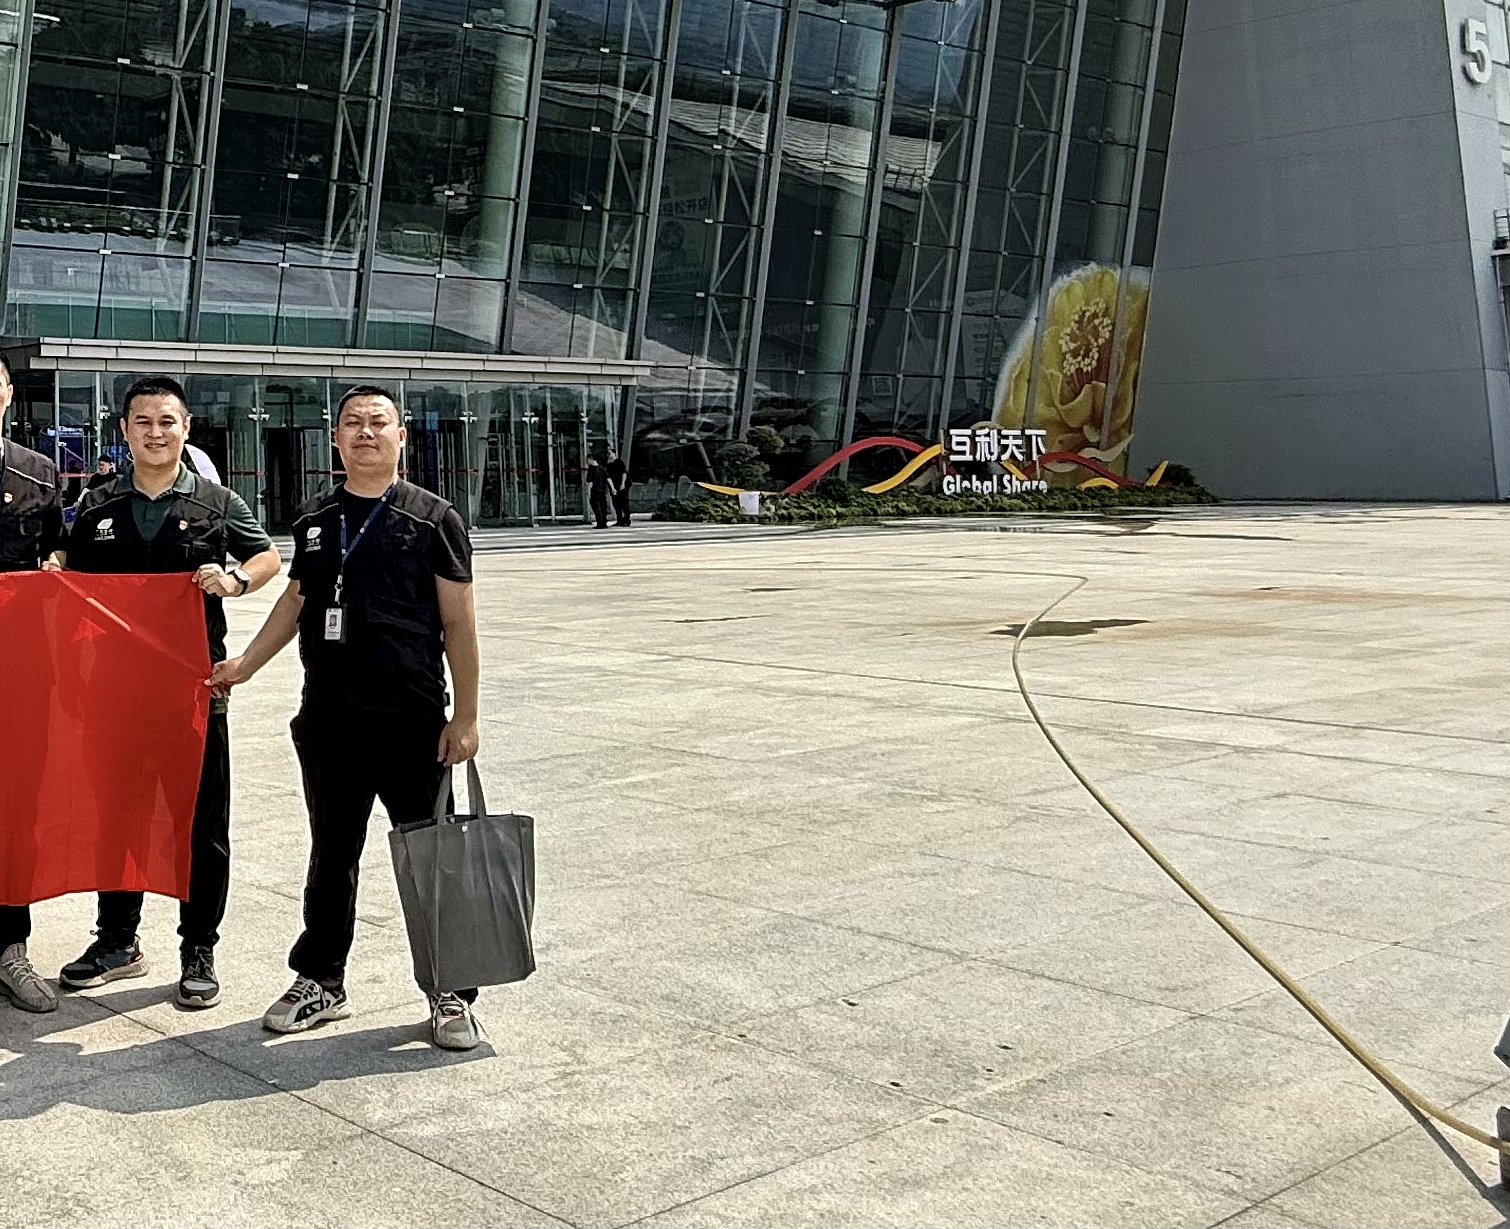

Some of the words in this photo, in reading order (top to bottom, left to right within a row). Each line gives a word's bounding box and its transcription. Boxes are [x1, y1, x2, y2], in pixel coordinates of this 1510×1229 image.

[1464, 18, 1492, 84] 5
[949, 428, 1047, 462] 互利天下
[942, 474, 999, 496] Global
[1002, 474, 1048, 495] Share
